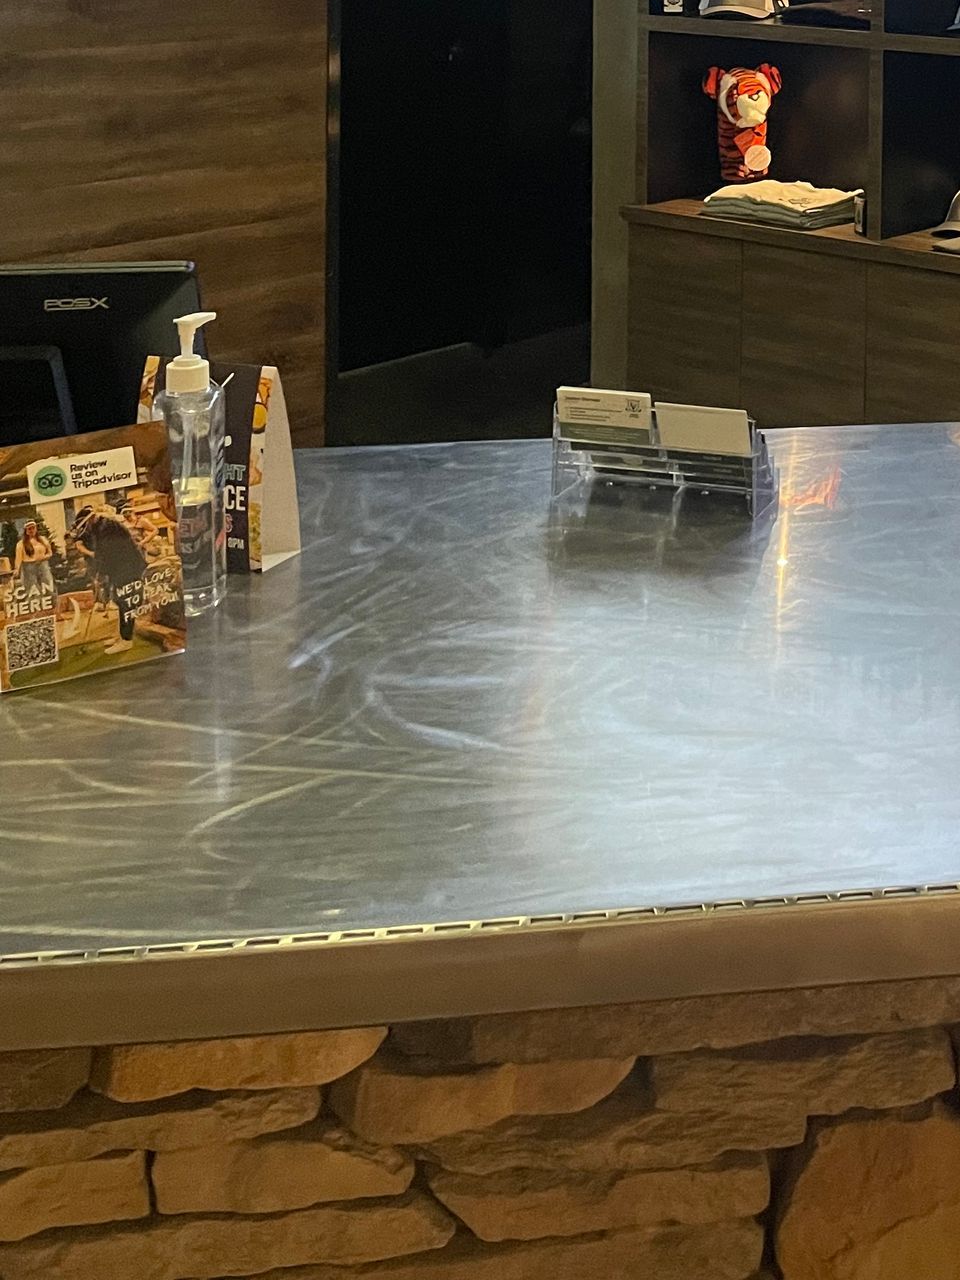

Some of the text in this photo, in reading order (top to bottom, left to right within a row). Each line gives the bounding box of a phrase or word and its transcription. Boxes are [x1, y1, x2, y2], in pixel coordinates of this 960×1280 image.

[70, 460, 107, 473] Review
[71, 472, 82, 480] us
[71, 472, 132, 489] Tripadvisor
[116, 567, 173, 597] WE'D LOVE
[3, 582, 54, 603] SCAN
[124, 582, 173, 608] TO HEAR
[5, 595, 53, 618] HERE
[124, 604, 158, 623] FROM
